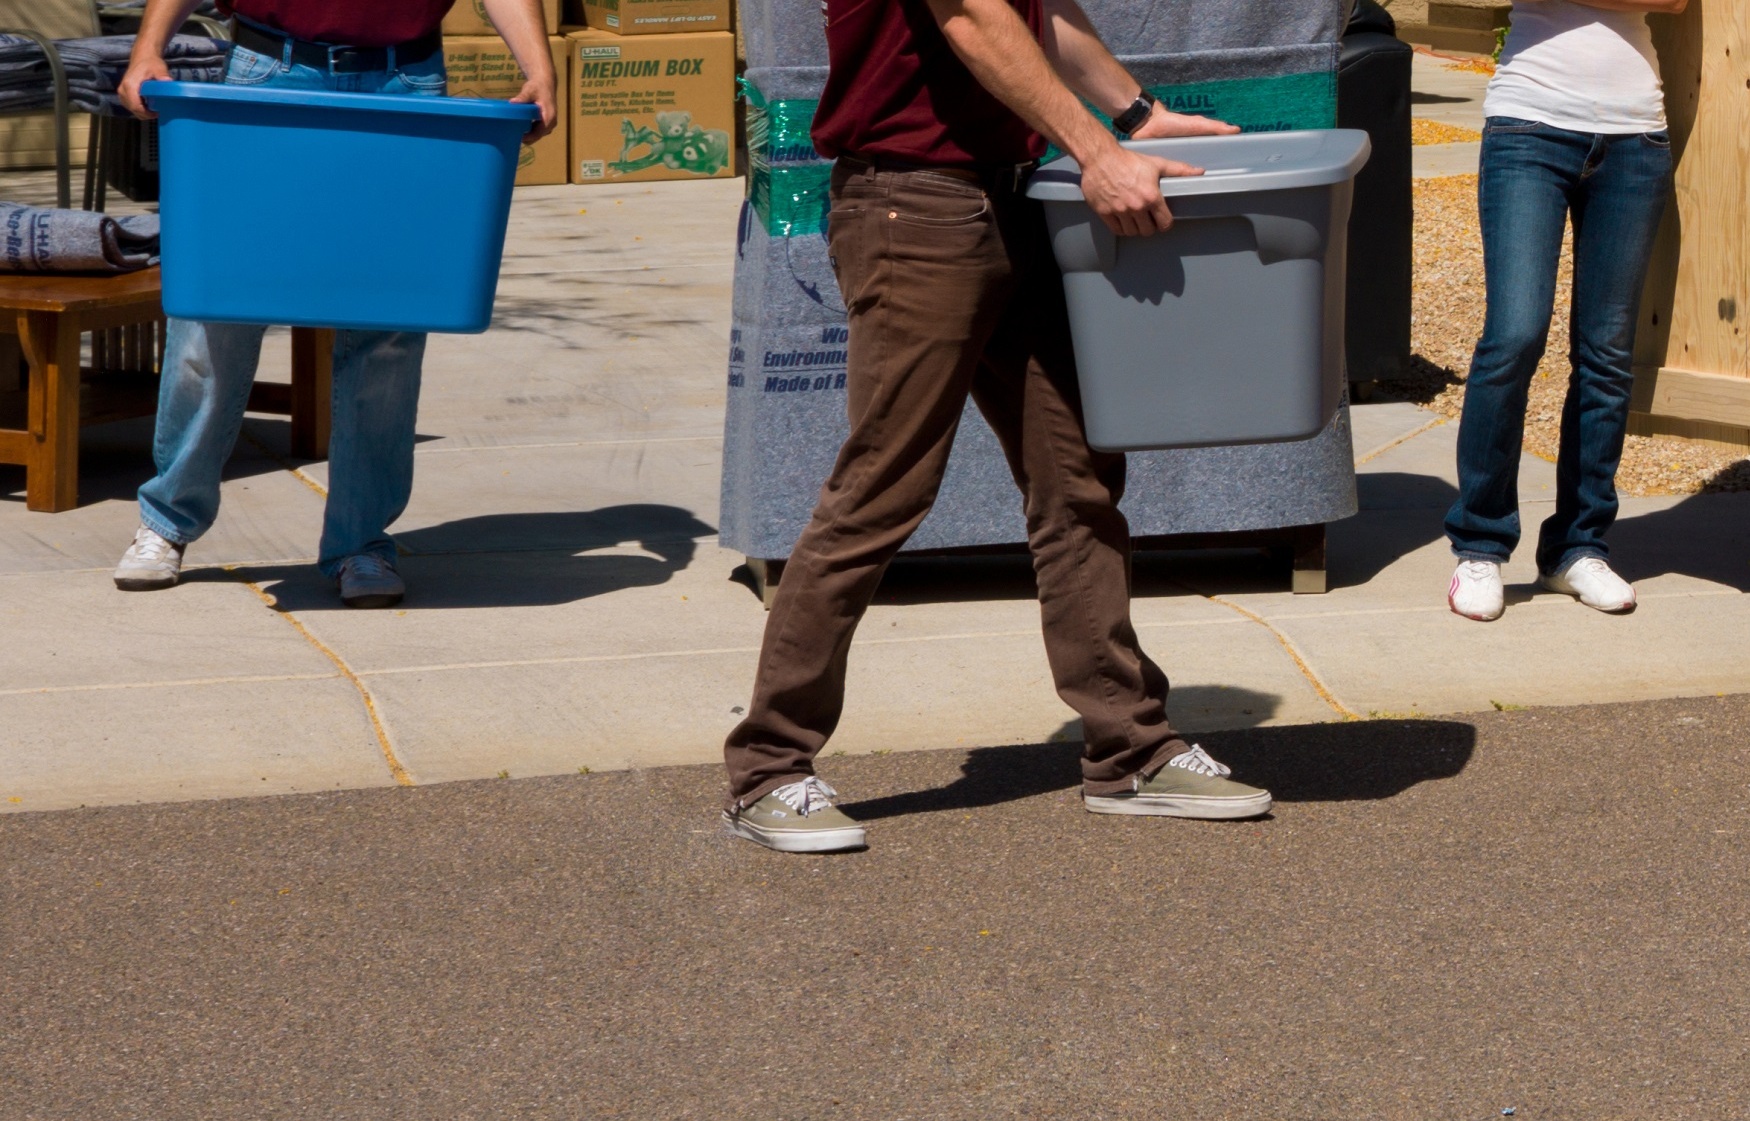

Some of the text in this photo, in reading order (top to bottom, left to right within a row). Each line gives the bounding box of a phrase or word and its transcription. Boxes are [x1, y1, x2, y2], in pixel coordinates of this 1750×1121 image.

[583, 48, 619, 56] U-HAUL
[581, 58, 705, 79] MEDIUM BOX
[764, 375, 811, 392] Made
[813, 373, 833, 390] of
